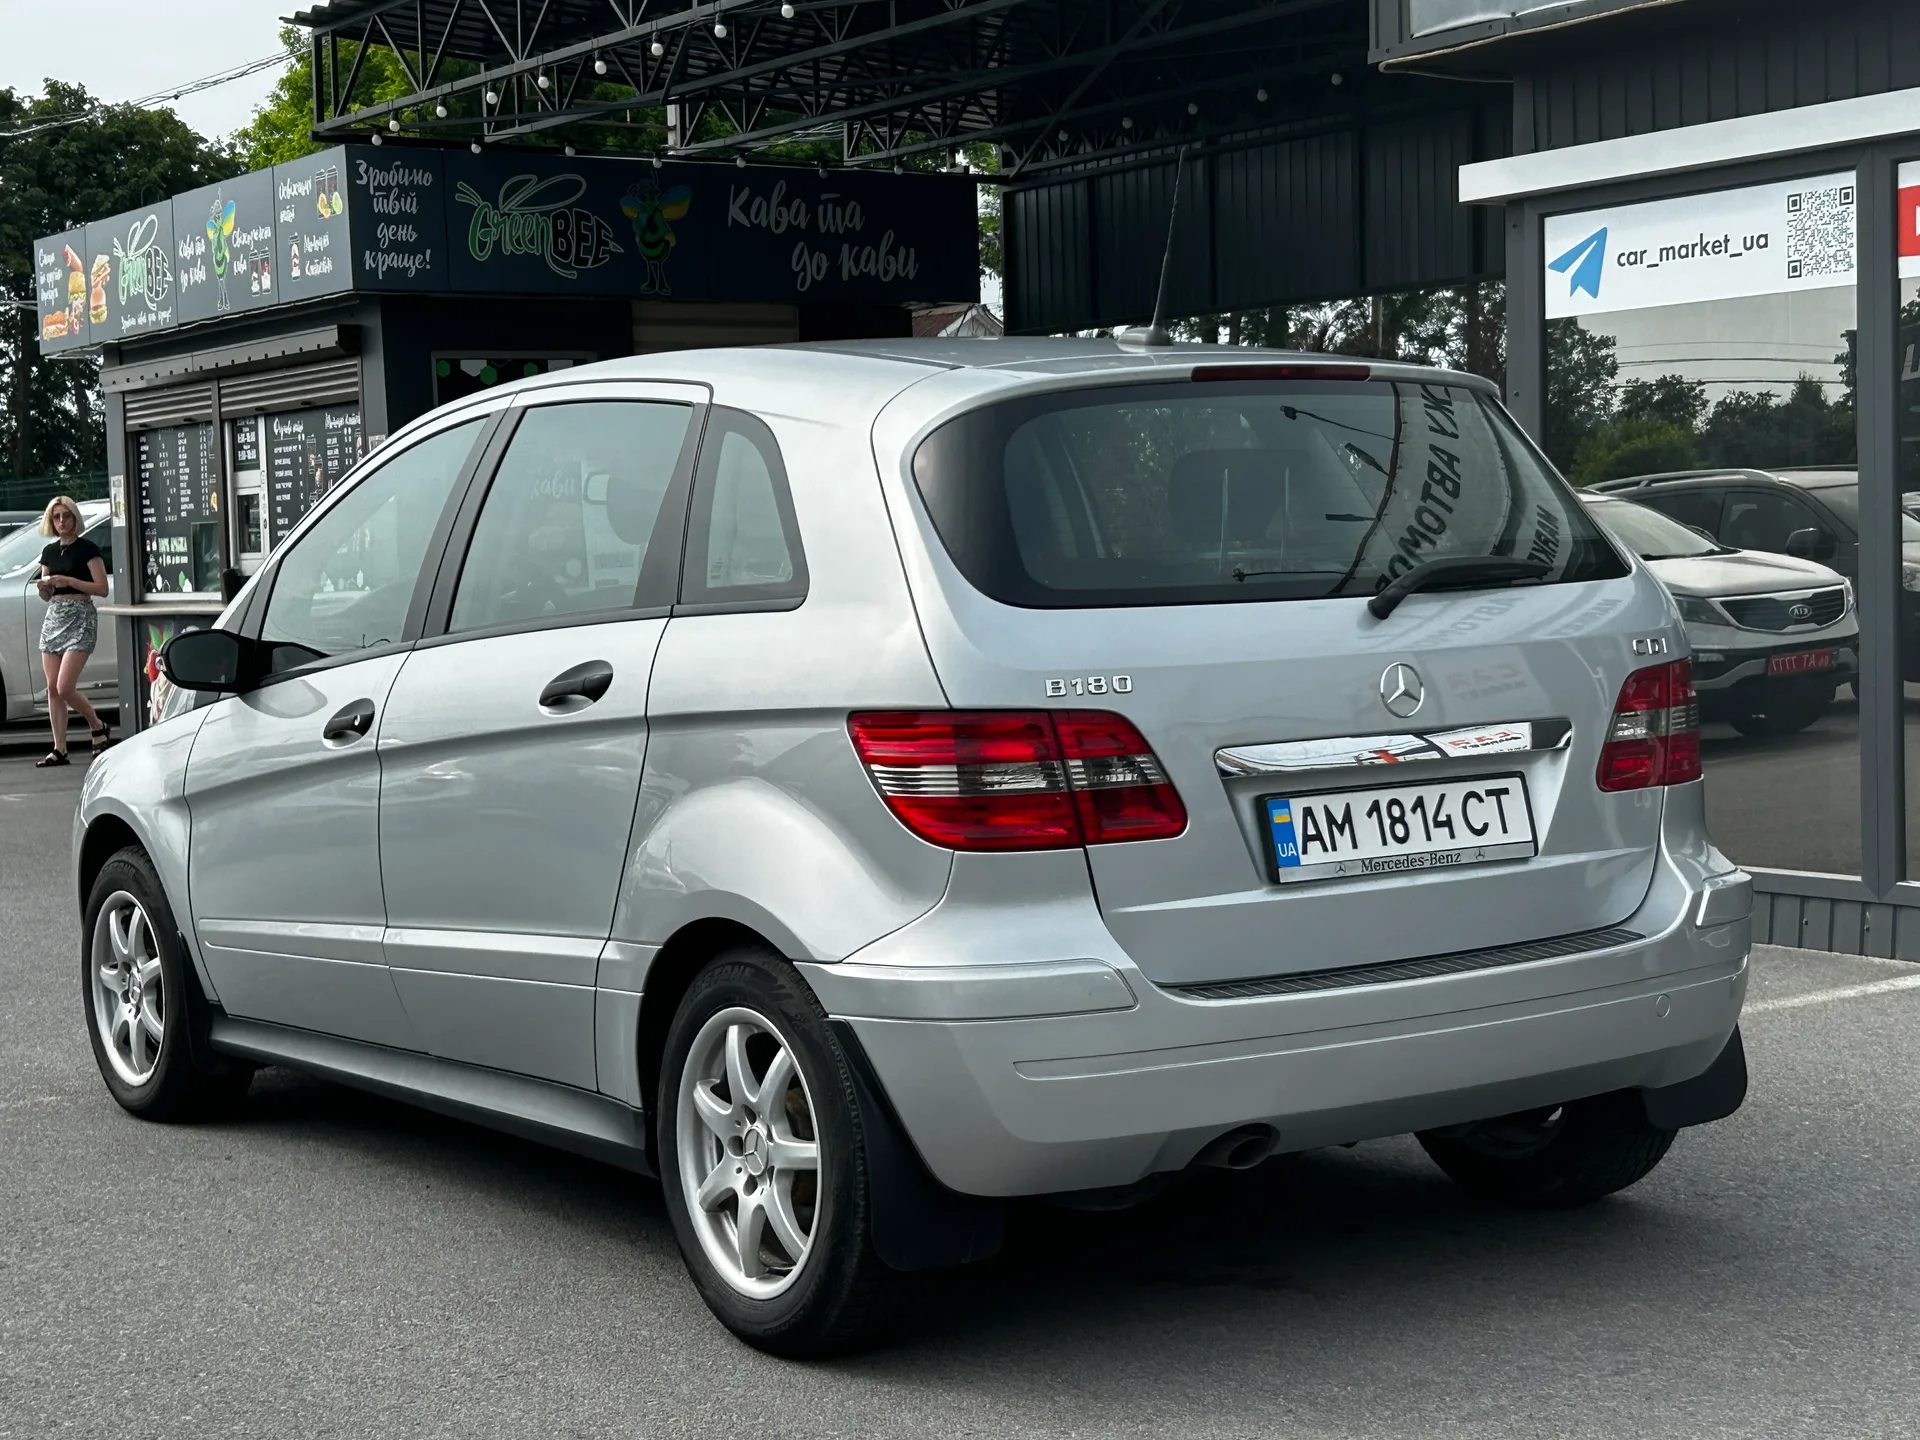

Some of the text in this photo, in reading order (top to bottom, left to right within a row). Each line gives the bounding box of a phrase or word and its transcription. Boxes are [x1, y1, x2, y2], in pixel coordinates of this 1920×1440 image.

[356, 160, 433, 195] Зробимо
[373, 187, 419, 215] твій
[728, 180, 865, 234] Кава та
[377, 222, 418, 249] день
[363, 249, 431, 280] краще!
[792, 229, 919, 292] до кави
[1617, 233, 1769, 268] car_market_ua
[1632, 638, 1667, 656] CDI
[1045, 675, 1133, 698] B180
[1301, 787, 1510, 855] AM 1814 CT
[1277, 842, 1297, 858] UA
[1361, 852, 1461, 873] Mercedes-Benz
